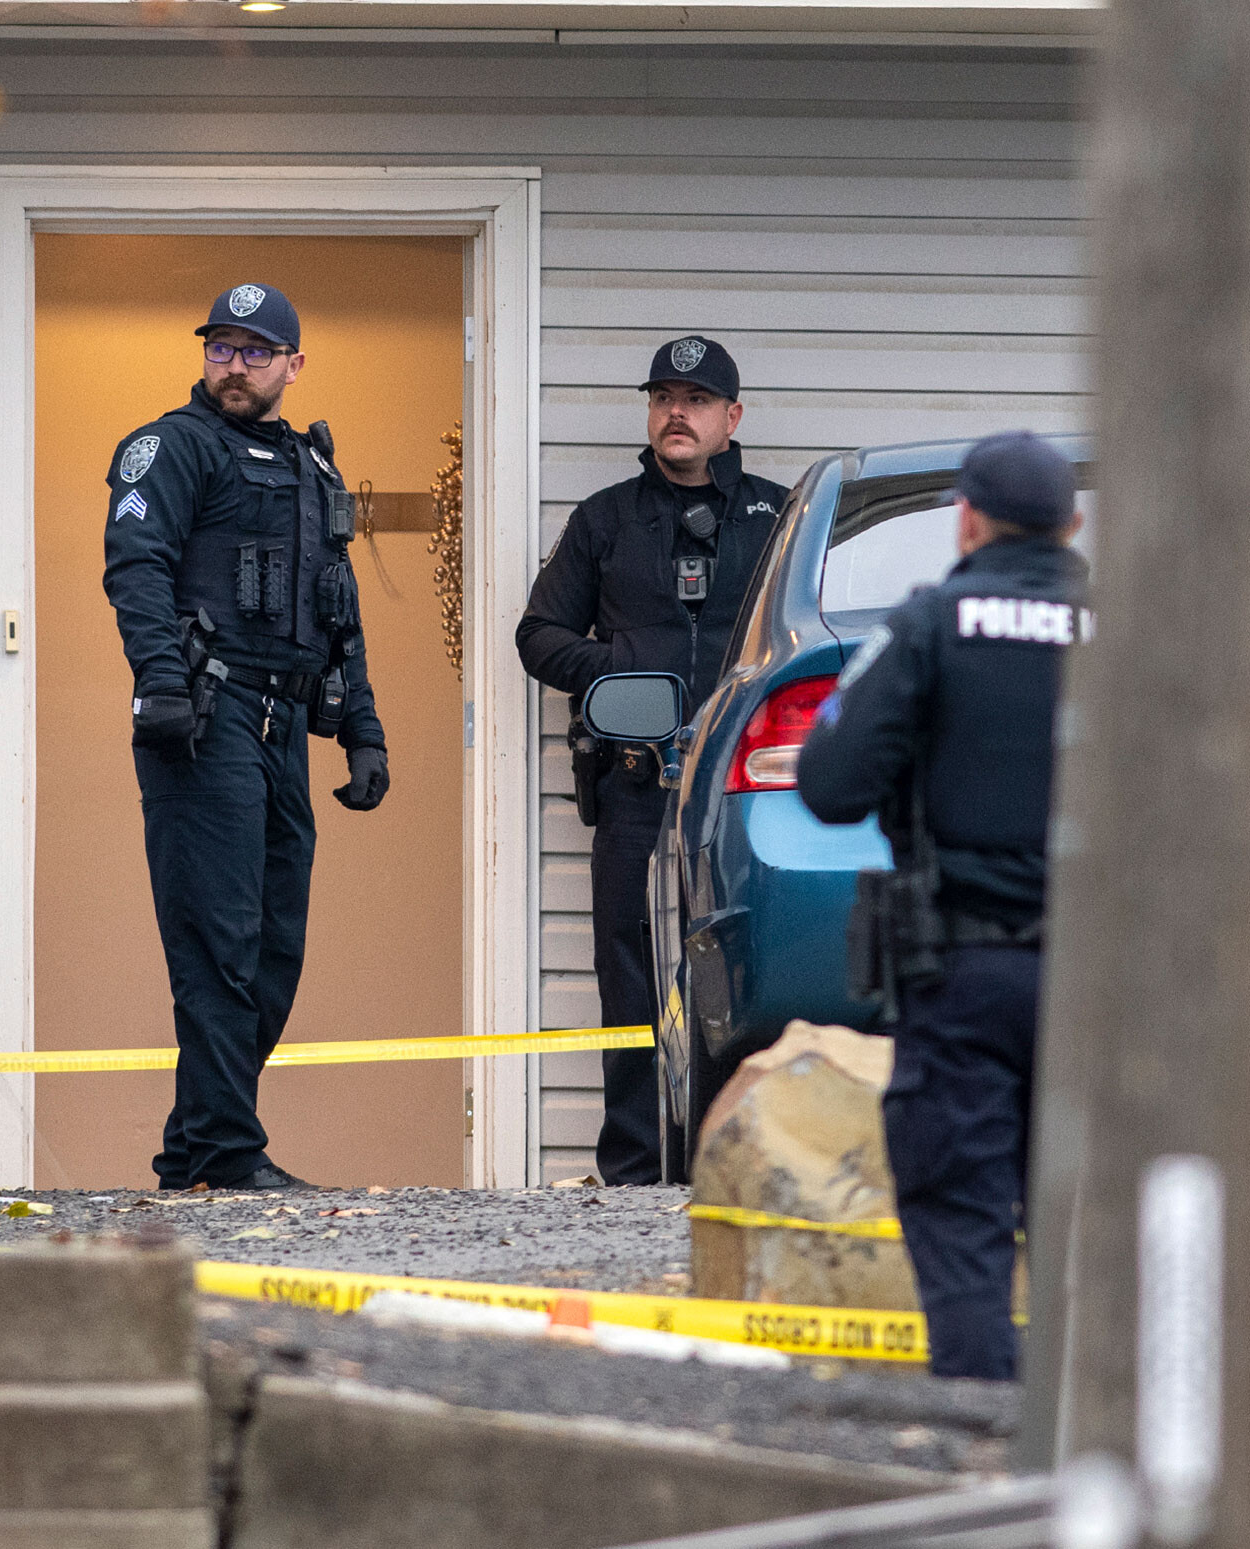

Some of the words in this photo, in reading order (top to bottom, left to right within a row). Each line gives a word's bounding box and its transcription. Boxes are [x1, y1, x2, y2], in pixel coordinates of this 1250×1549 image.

[958, 597, 1073, 646] POLICE
[743, 1312, 820, 1348] CROSS
[830, 1318, 873, 1349] NOT
[883, 1322, 915, 1352] DO
